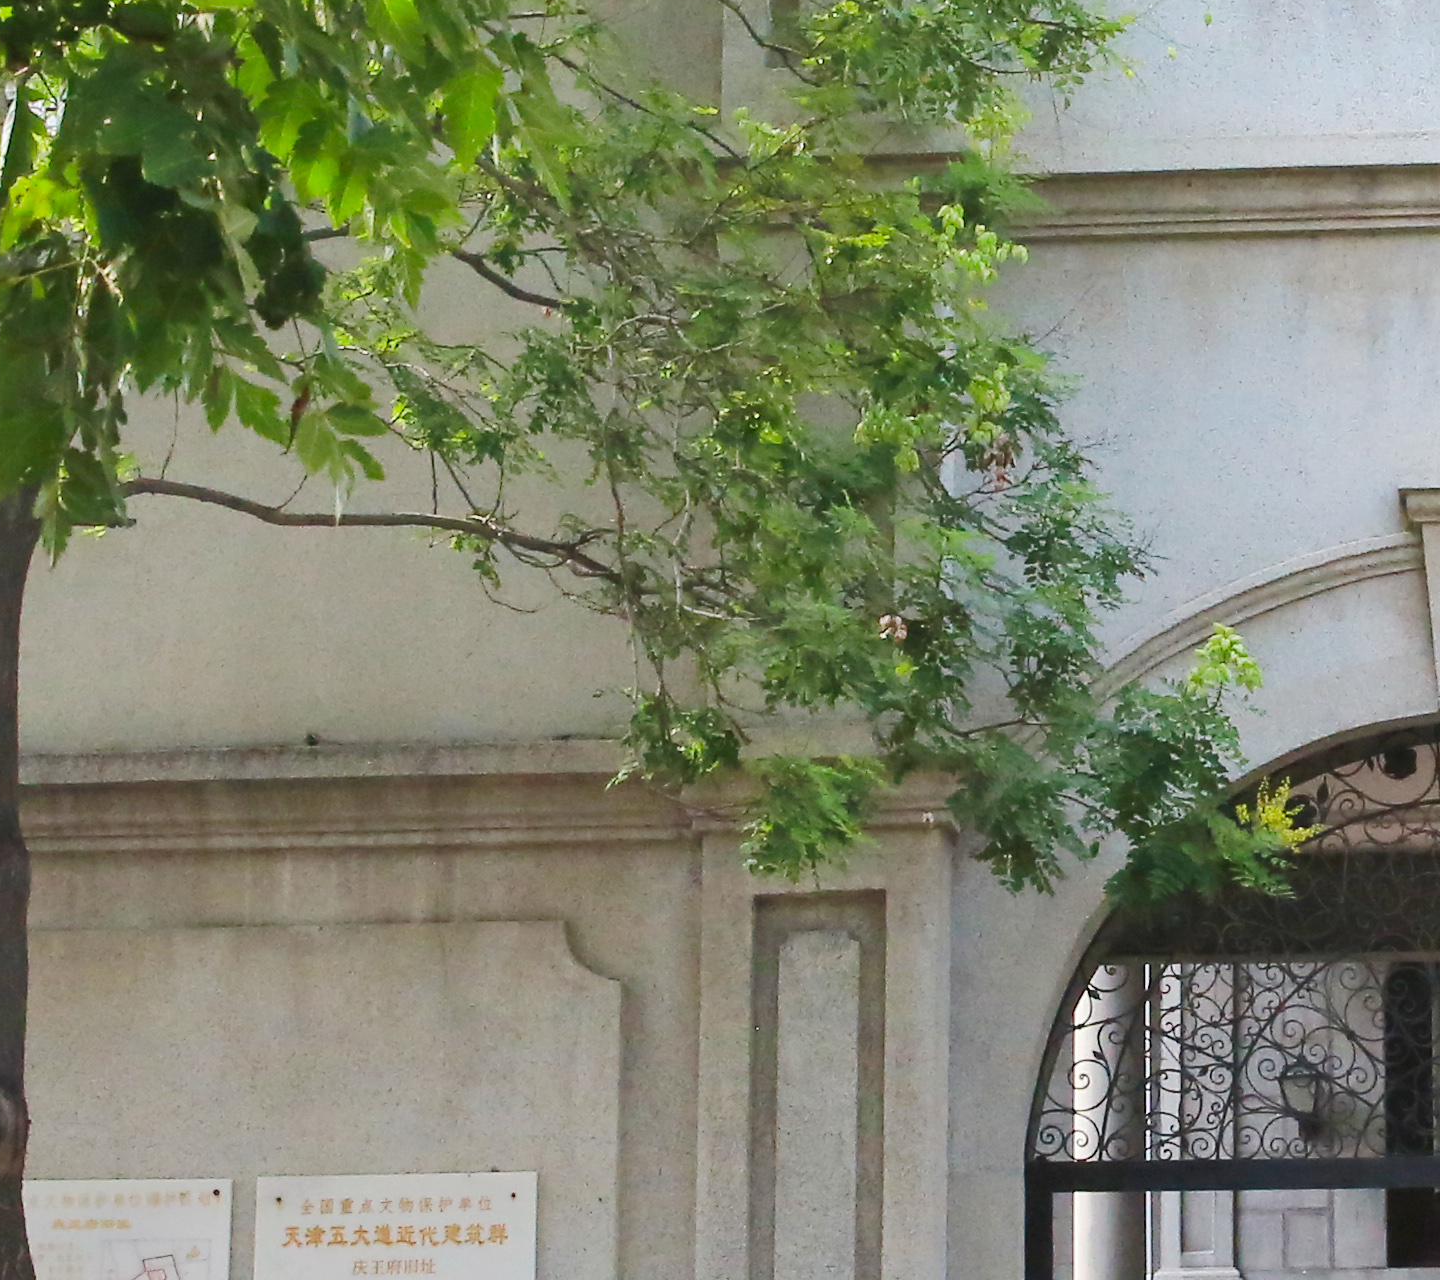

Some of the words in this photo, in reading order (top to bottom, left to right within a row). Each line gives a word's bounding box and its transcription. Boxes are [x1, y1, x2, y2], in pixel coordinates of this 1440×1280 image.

[301, 1196, 492, 1215] 全国重点文物保护单位
[282, 1223, 509, 1247] 天津五大道近代建筑群
[353, 1258, 436, 1275] 庆王府旧址
